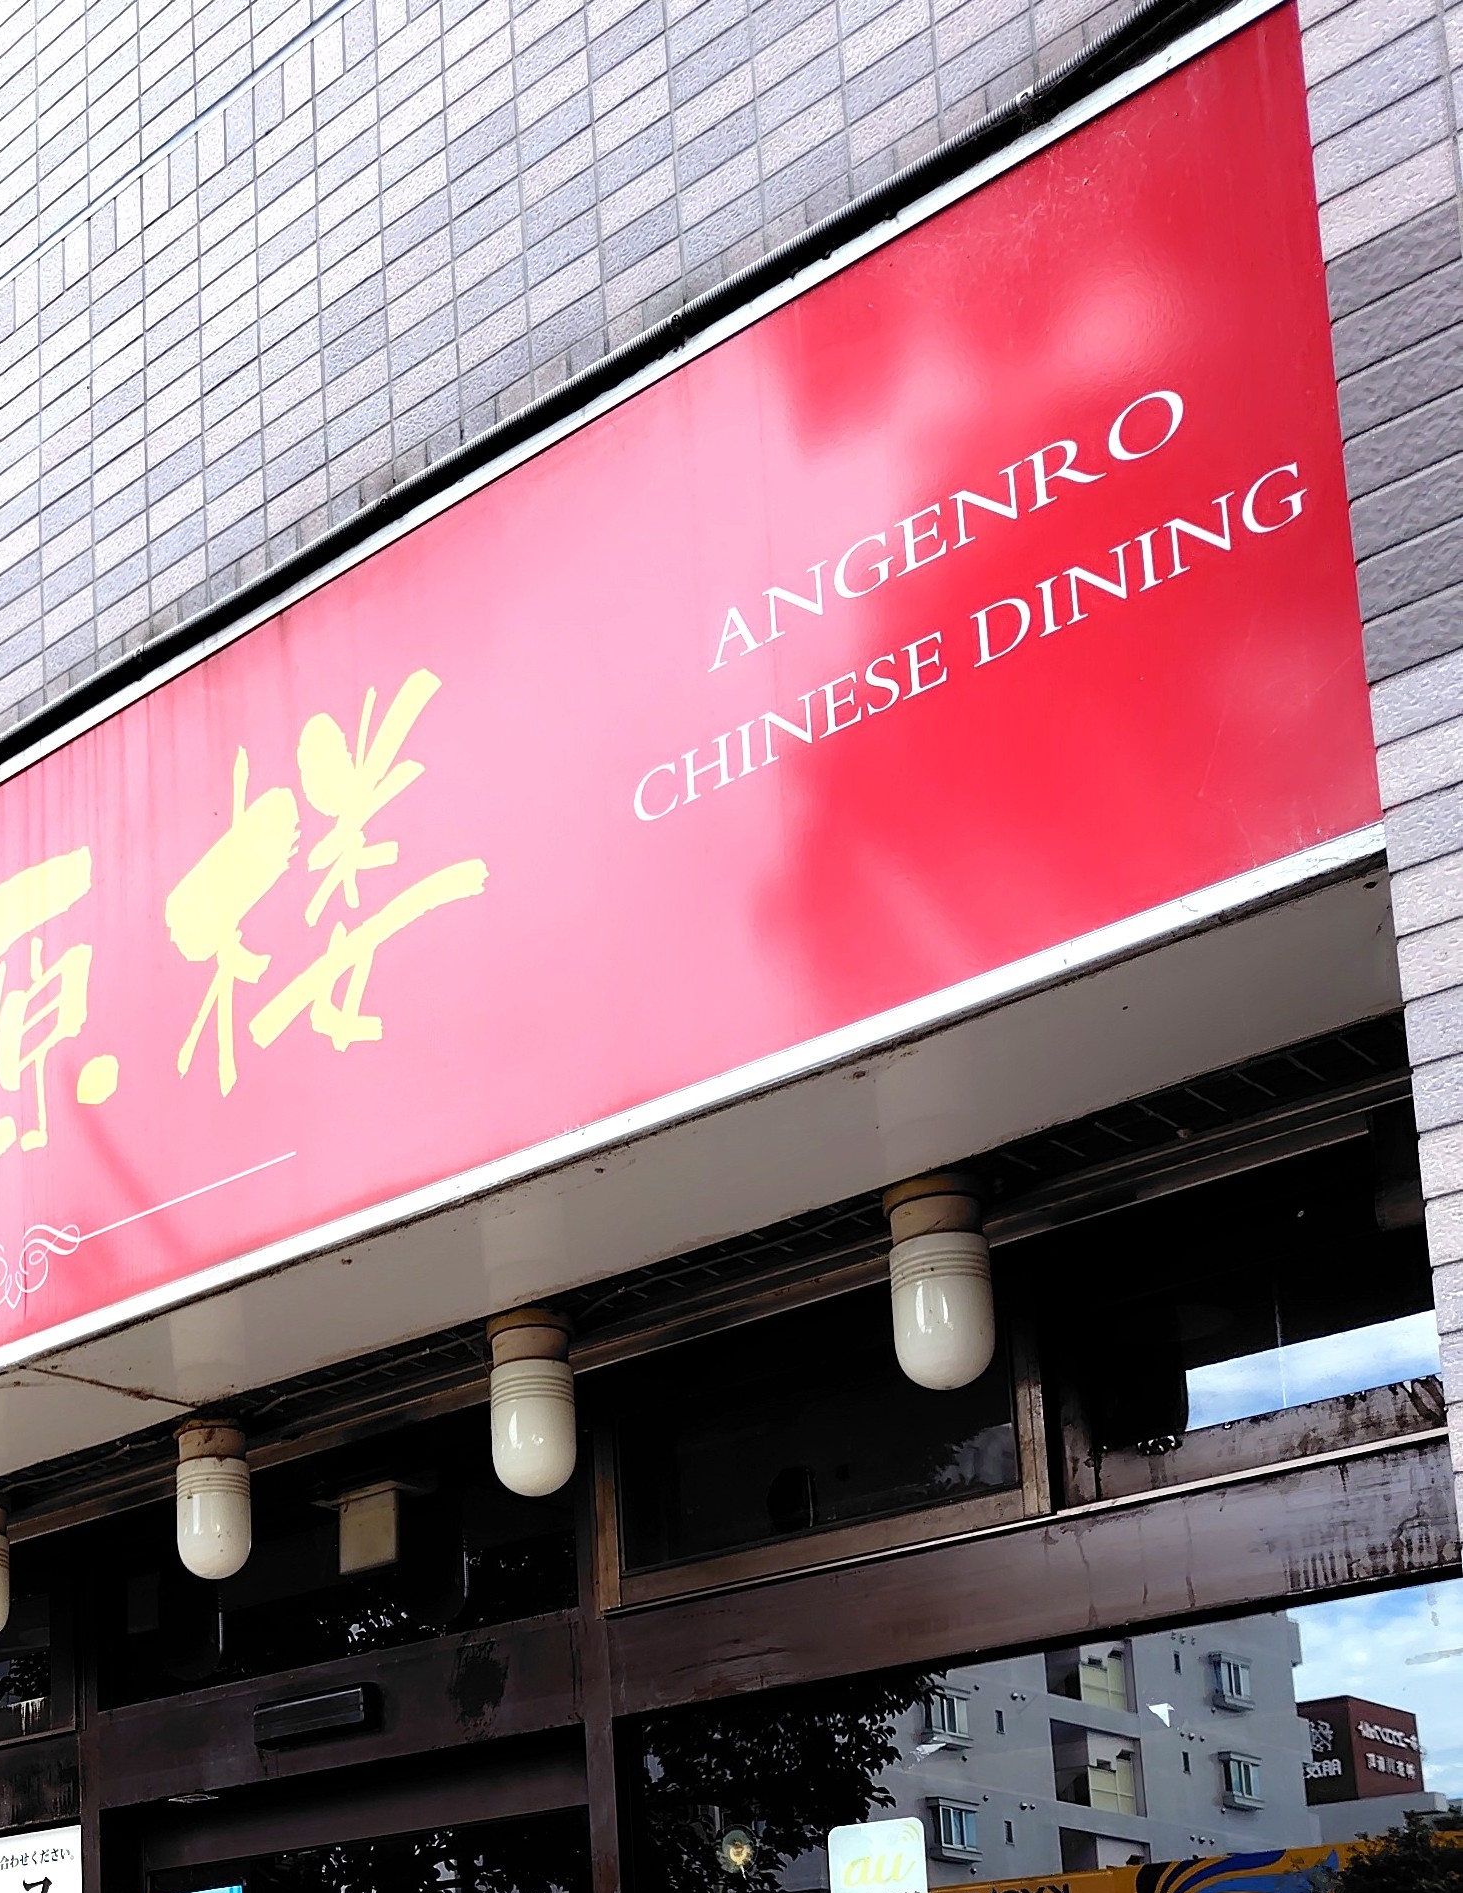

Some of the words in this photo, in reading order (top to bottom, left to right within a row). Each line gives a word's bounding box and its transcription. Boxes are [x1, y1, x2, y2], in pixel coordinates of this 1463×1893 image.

[633, 630, 949, 821] CHINESE
[970, 462, 1307, 667] DINING
[708, 390, 1184, 672] ANGENRO
[844, 1852, 916, 1887] au
